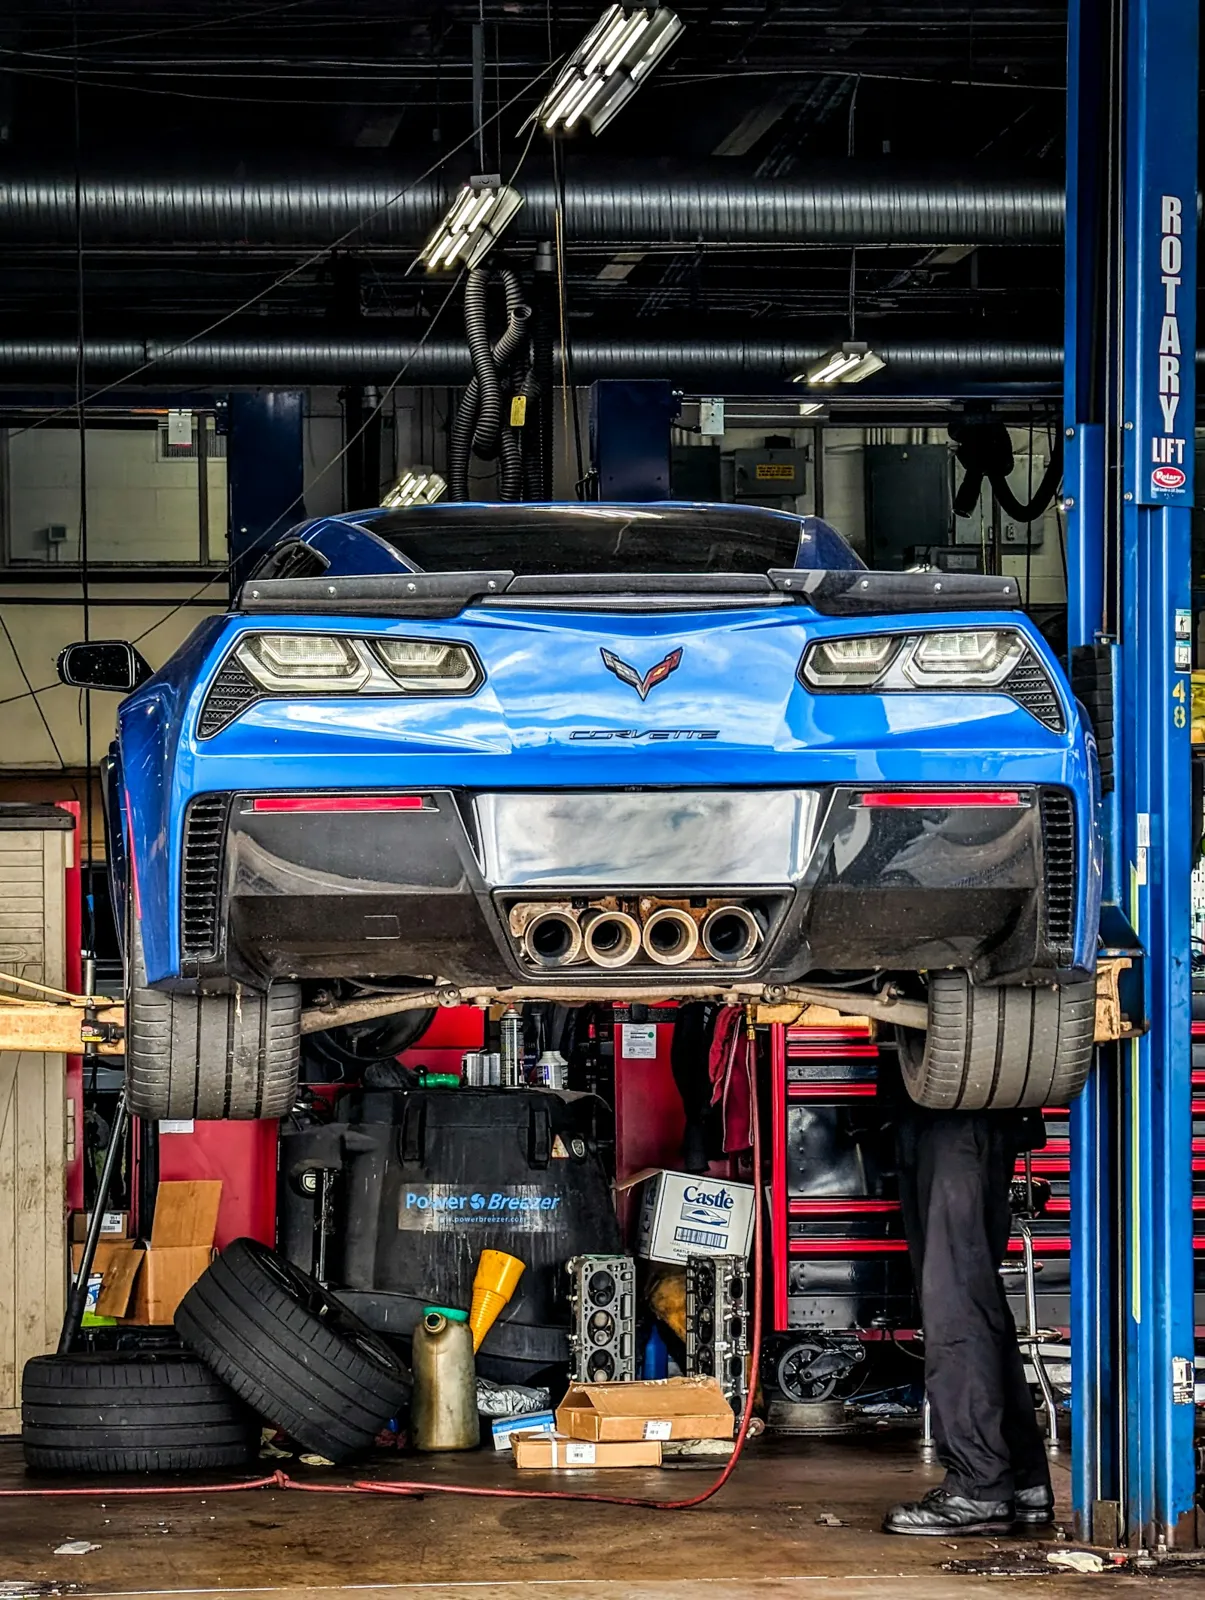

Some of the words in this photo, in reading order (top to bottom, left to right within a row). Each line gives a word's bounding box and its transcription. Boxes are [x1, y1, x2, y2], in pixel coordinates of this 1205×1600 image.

[1159, 195, 1182, 434] ROTARY
[1152, 437, 1186, 464] LIFT
[569, 729, 720, 740] CORVETTE
[405, 1192, 467, 1210] Power
[488, 1193, 560, 1211] Breezer
[683, 1186, 734, 1209] Castle
[439, 1214, 527, 1224] w.powerbreezer.com
